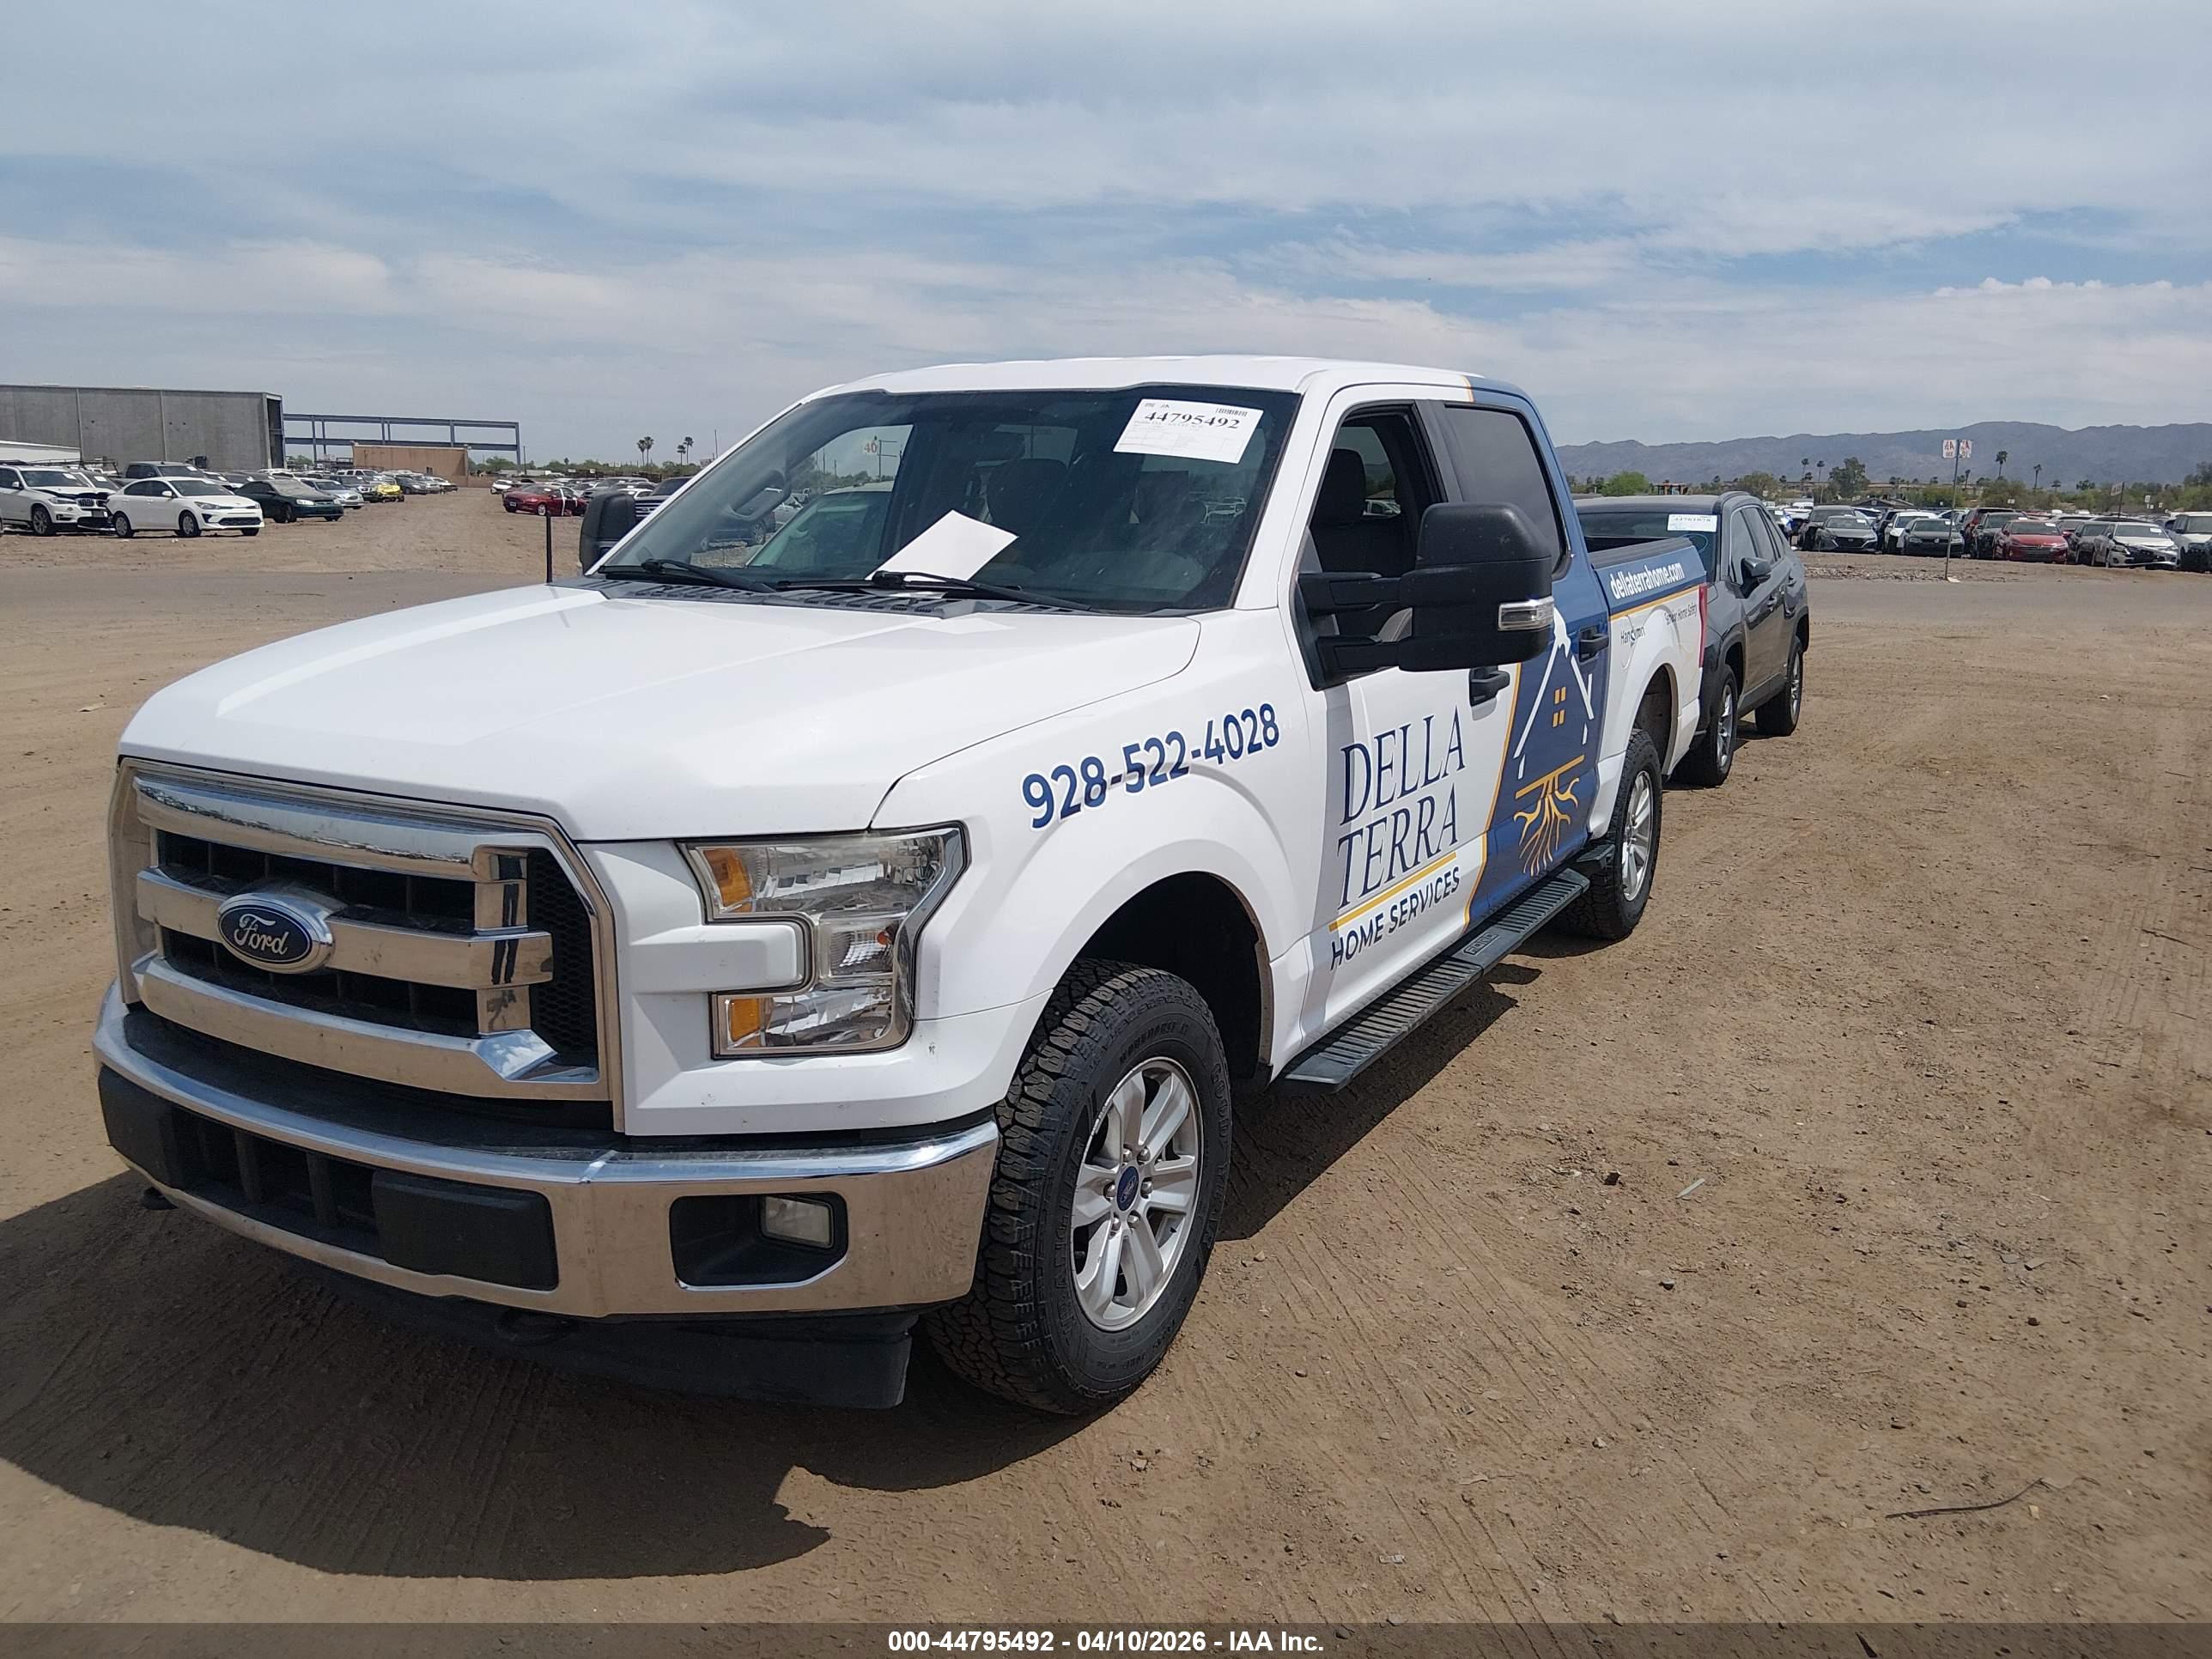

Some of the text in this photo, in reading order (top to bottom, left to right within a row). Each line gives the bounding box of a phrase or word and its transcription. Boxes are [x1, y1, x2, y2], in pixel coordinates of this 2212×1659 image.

[1144, 411, 1240, 429] 44795492
[1609, 562, 1685, 599] dellaterrahome.com
[1022, 703, 1279, 829] 928-522-4028
[1340, 704, 1465, 826] DELLA
[1337, 782, 1458, 910] TERRA
[234, 913, 289, 955] Ford
[1330, 866, 1460, 971] HOME SERVICES
